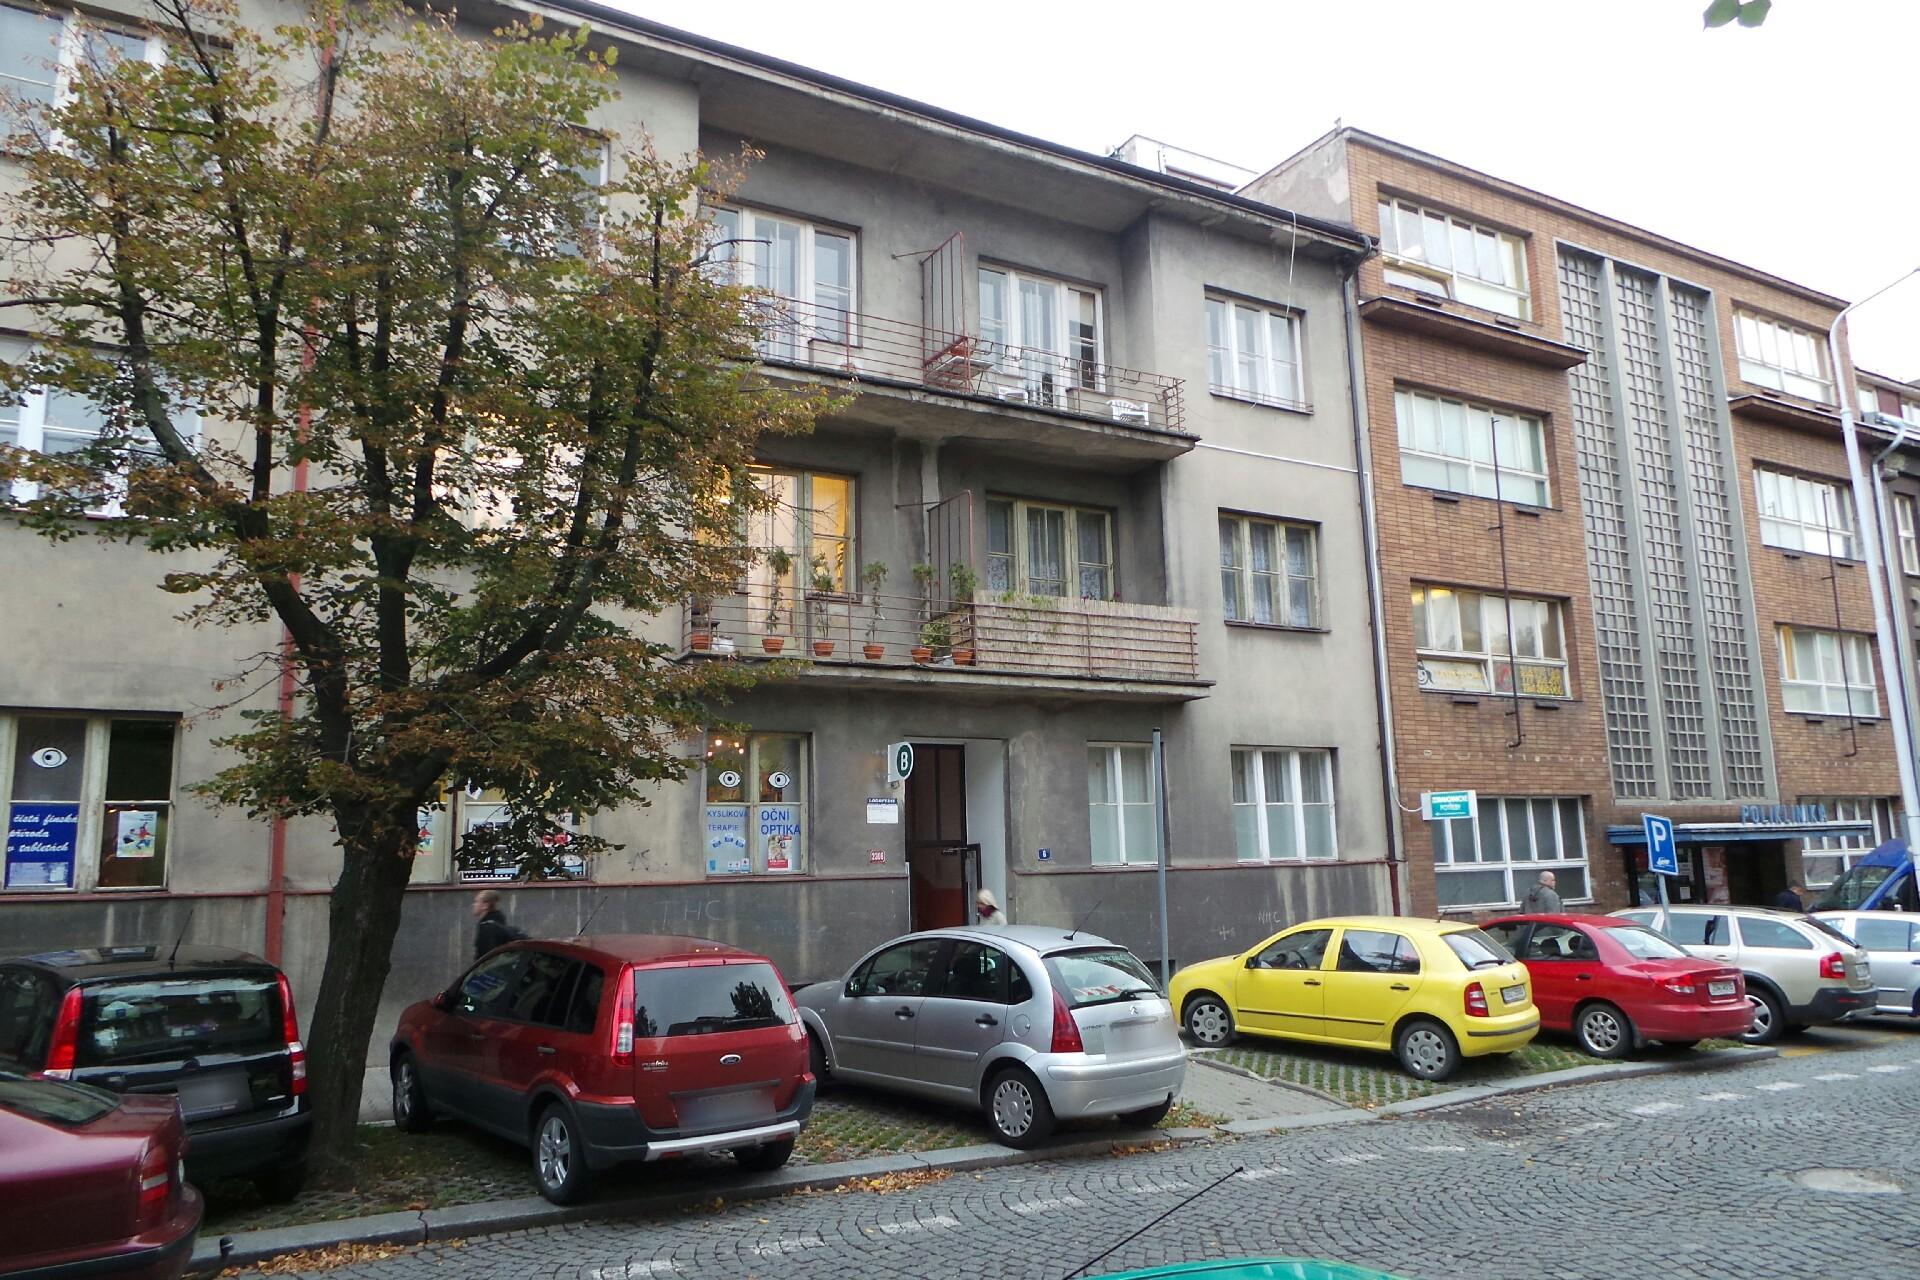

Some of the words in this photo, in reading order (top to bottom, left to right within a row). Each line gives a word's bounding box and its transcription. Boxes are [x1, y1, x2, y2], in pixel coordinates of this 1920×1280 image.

[900, 751, 909, 771] B
[13, 814, 40, 823] čistá
[761, 808, 790, 821] OČNÍ
[1741, 804, 1828, 825] POLIKLINIKA
[708, 824, 740, 832] TERAPIE
[760, 824, 801, 835] OPTIKA
[1651, 821, 1666, 852] P
[19, 841, 70, 853] tabletách
